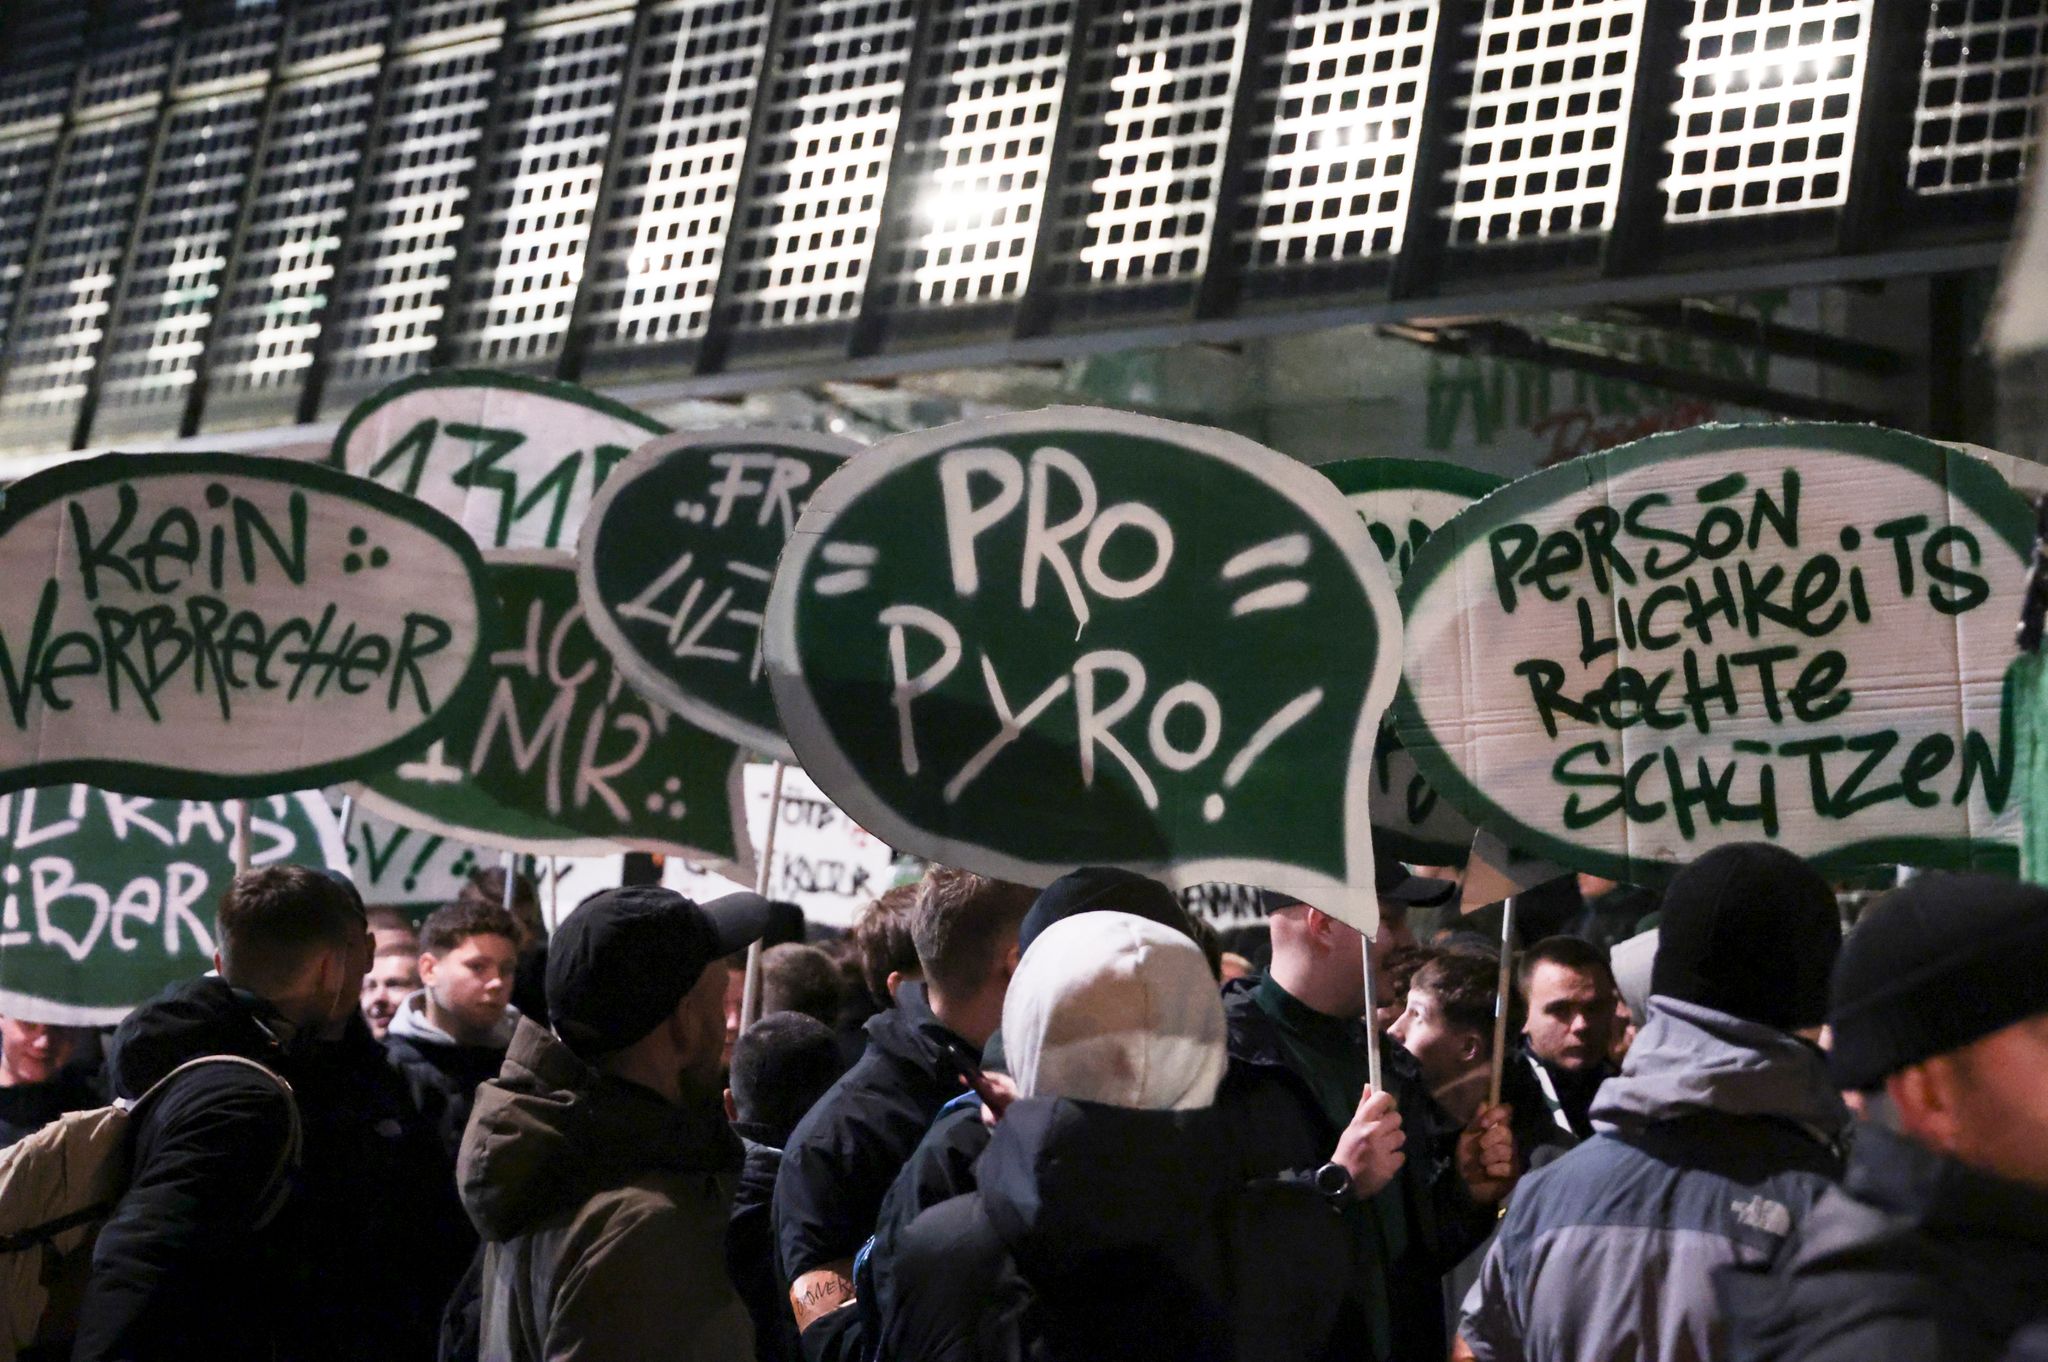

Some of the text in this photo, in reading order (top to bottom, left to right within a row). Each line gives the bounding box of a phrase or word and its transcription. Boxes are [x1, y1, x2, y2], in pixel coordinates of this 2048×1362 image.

[368, 416, 634, 549] 131
[938, 446, 1174, 642] PRO
[877, 604, 1324, 823] PYRO!
